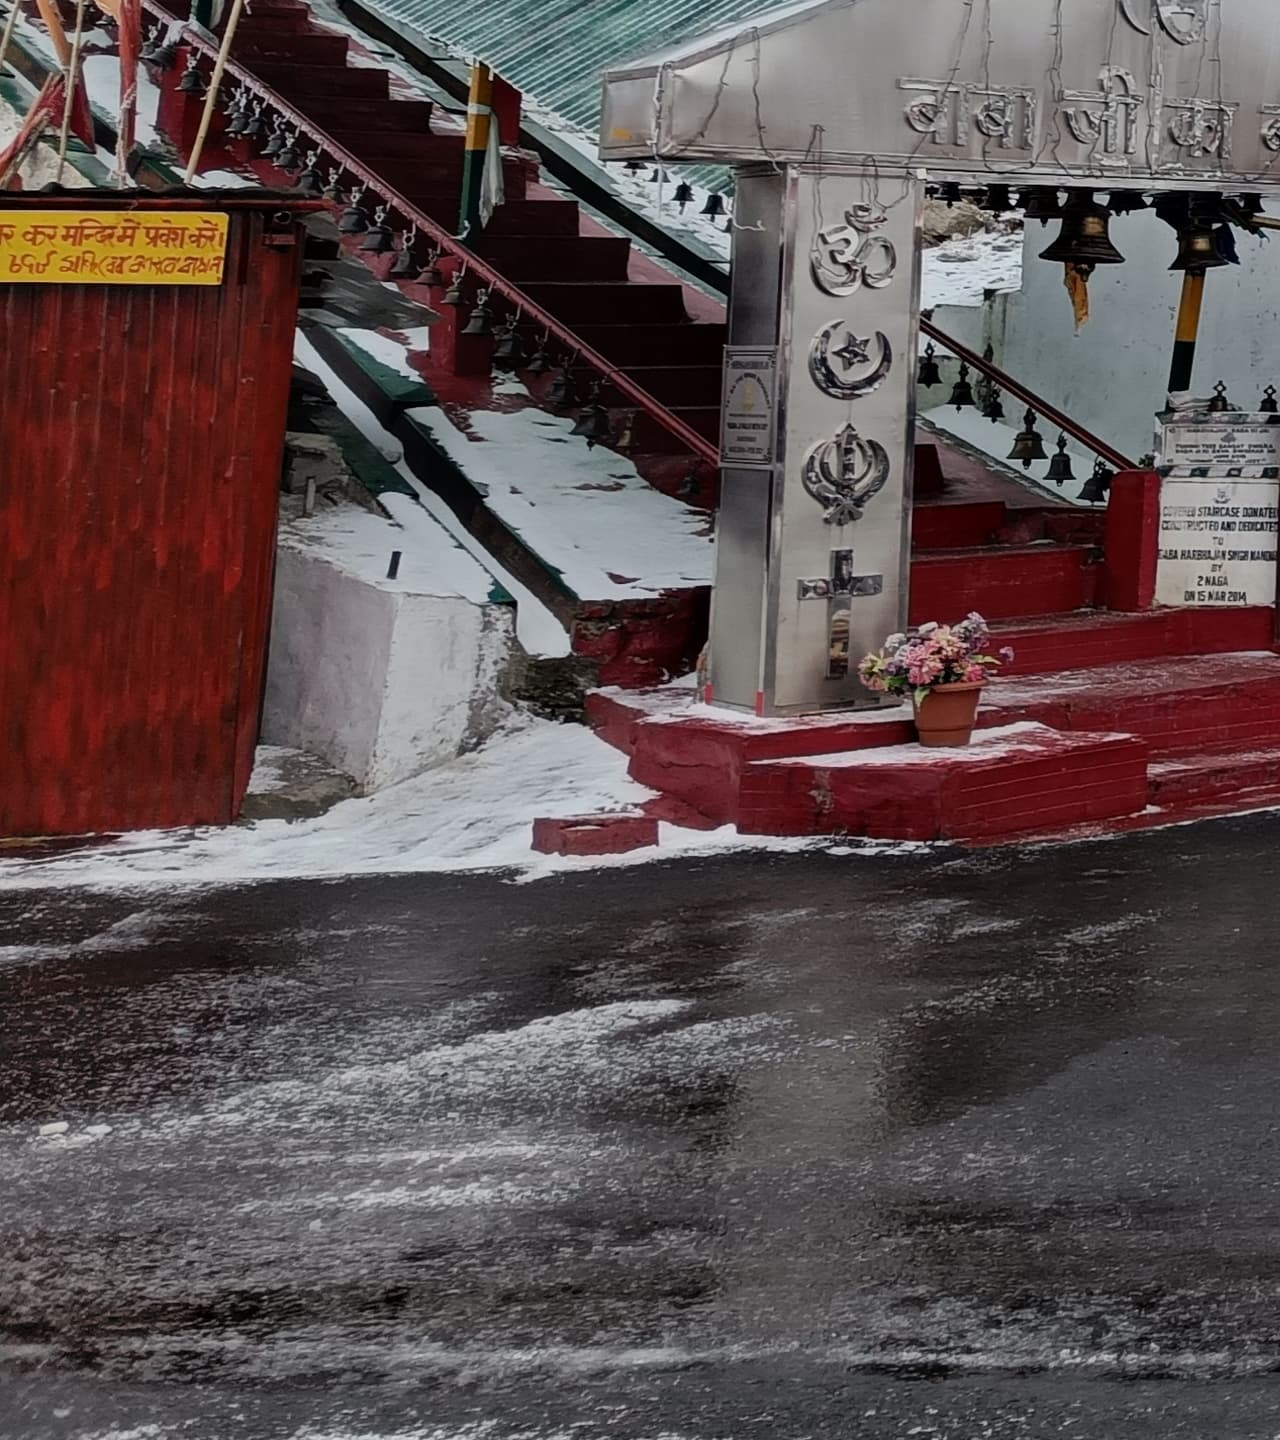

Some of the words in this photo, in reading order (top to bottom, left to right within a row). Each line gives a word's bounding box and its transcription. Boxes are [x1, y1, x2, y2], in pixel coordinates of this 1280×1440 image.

[896, 77, 1036, 150] बाबा
[1057, 64, 1144, 155] जी
[1164, 95, 1241, 160] का
[1197, 506, 1240, 518] STAIRCASE
[1221, 521, 1237, 531] AND
[1212, 536, 1224, 546] TO
[1180, 549, 1226, 560] HARBHAJAN
[1211, 562, 1223, 572] BY
[1197, 575, 1204, 586] 2
[1205, 575, 1228, 586] NAGA
[1184, 590, 1195, 601] ON
[1197, 590, 1206, 601] 15
[1208, 590, 1226, 602] MAR
